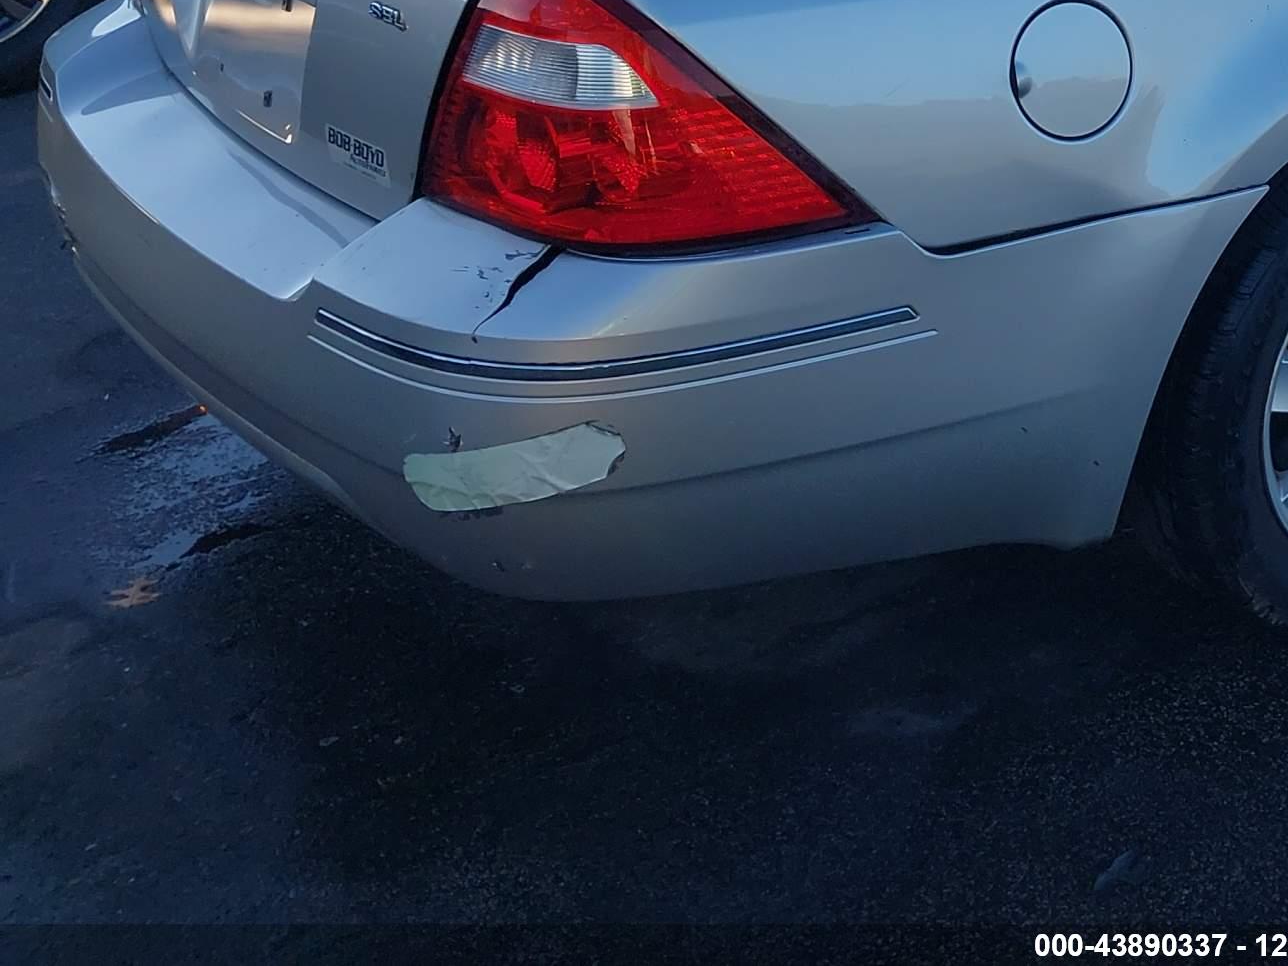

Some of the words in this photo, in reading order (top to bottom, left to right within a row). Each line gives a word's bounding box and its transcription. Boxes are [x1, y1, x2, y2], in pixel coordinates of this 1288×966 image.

[368, 0, 407, 32] SEL
[328, 126, 351, 152] BOB
[353, 138, 385, 168] BOYD
